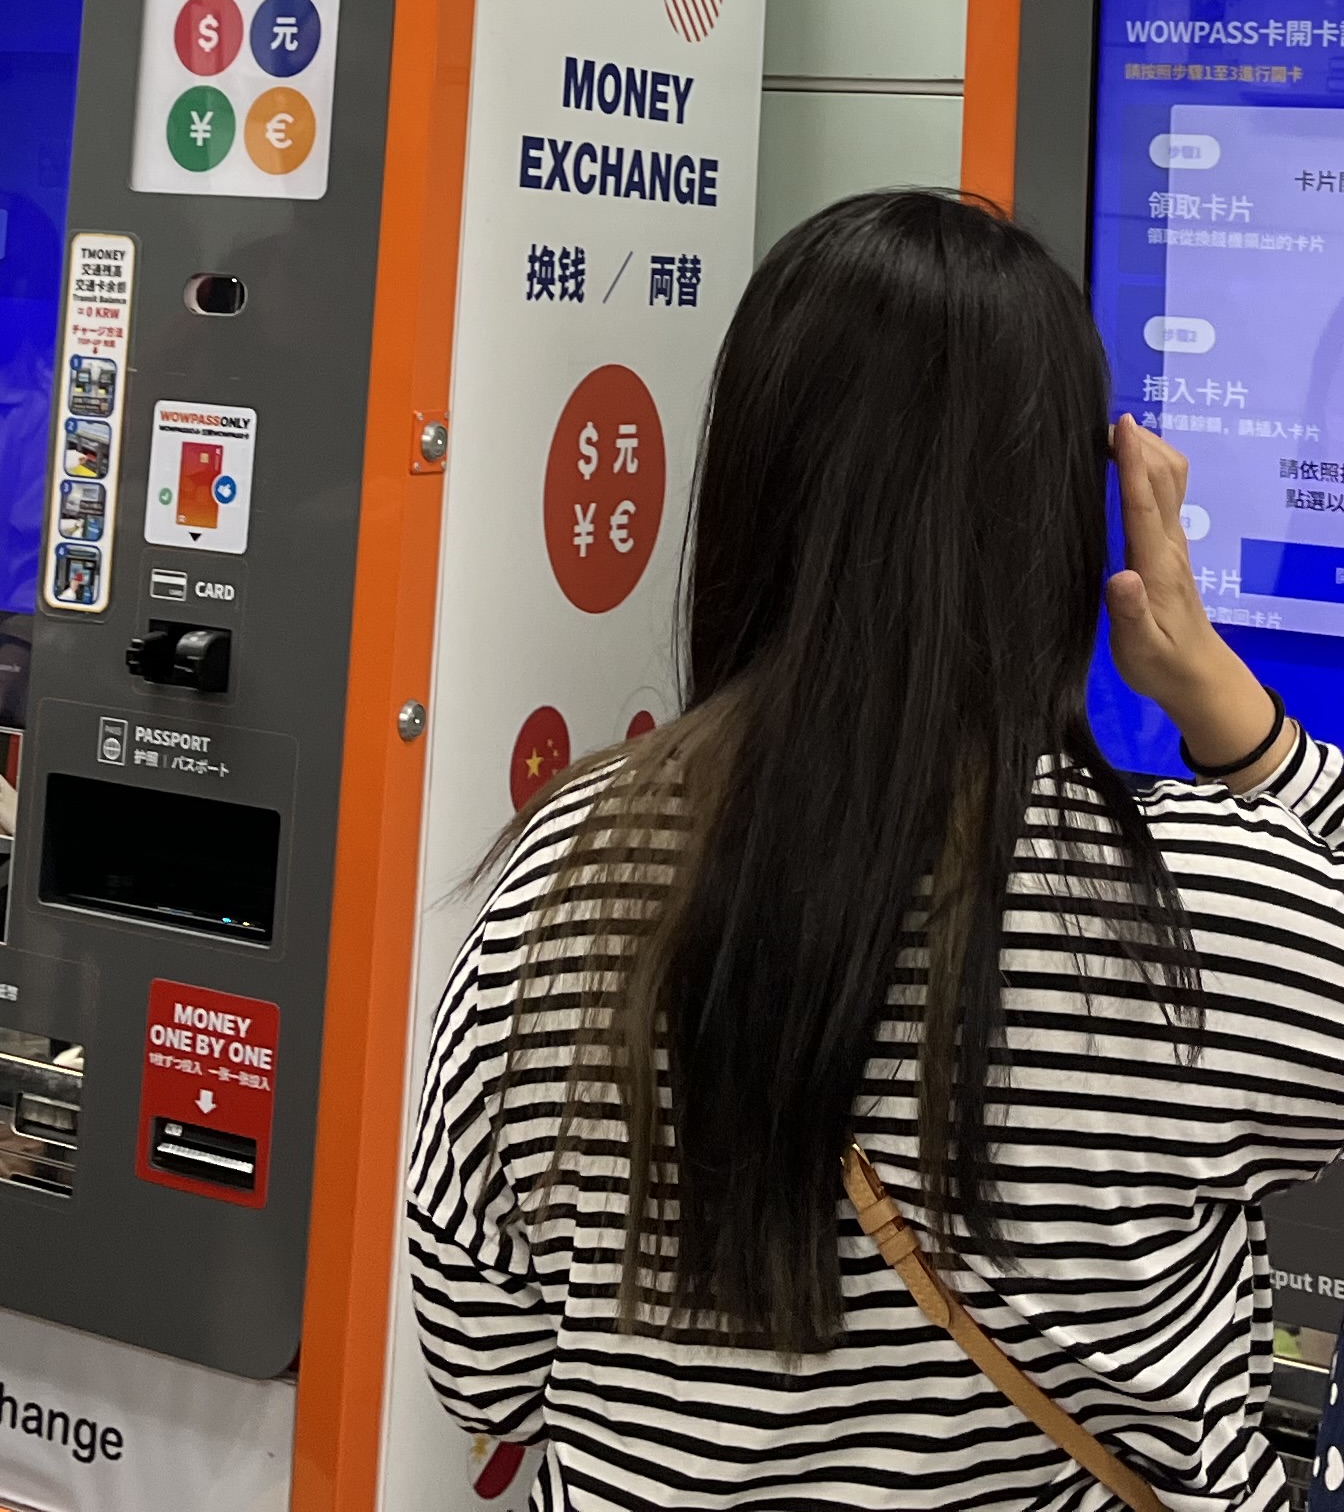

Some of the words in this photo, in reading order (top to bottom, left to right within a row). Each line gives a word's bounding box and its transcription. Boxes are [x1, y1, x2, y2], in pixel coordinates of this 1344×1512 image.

[197, 14, 219, 52] $
[270, 16, 299, 51] 元
[562, 55, 694, 124] MONEY
[189, 111, 214, 146] ¥
[265, 112, 293, 148] €
[519, 134, 719, 207] EXCHANGE
[1148, 192, 1253, 222] 領取卡片
[81, 248, 126, 261] TMONEY
[526, 243, 585, 305] 换钱
[650, 254, 702, 308] 両替
[1143, 374, 1249, 409] 插入卡片
[577, 421, 599, 480] $
[613, 423, 639, 474] 元
[573, 503, 597, 557] ¥
[609, 499, 636, 553] €
[195, 582, 235, 600] CARD
[1193, 566, 1242, 598] 卡片
[135, 726, 211, 752] PASSPORT
[174, 1003, 252, 1038] MONEY
[150, 1024, 193, 1052] ONE
[195, 1033, 226, 1059] BY
[228, 1042, 273, 1070] ONE
[1269, 1269, 1313, 1293] tput
